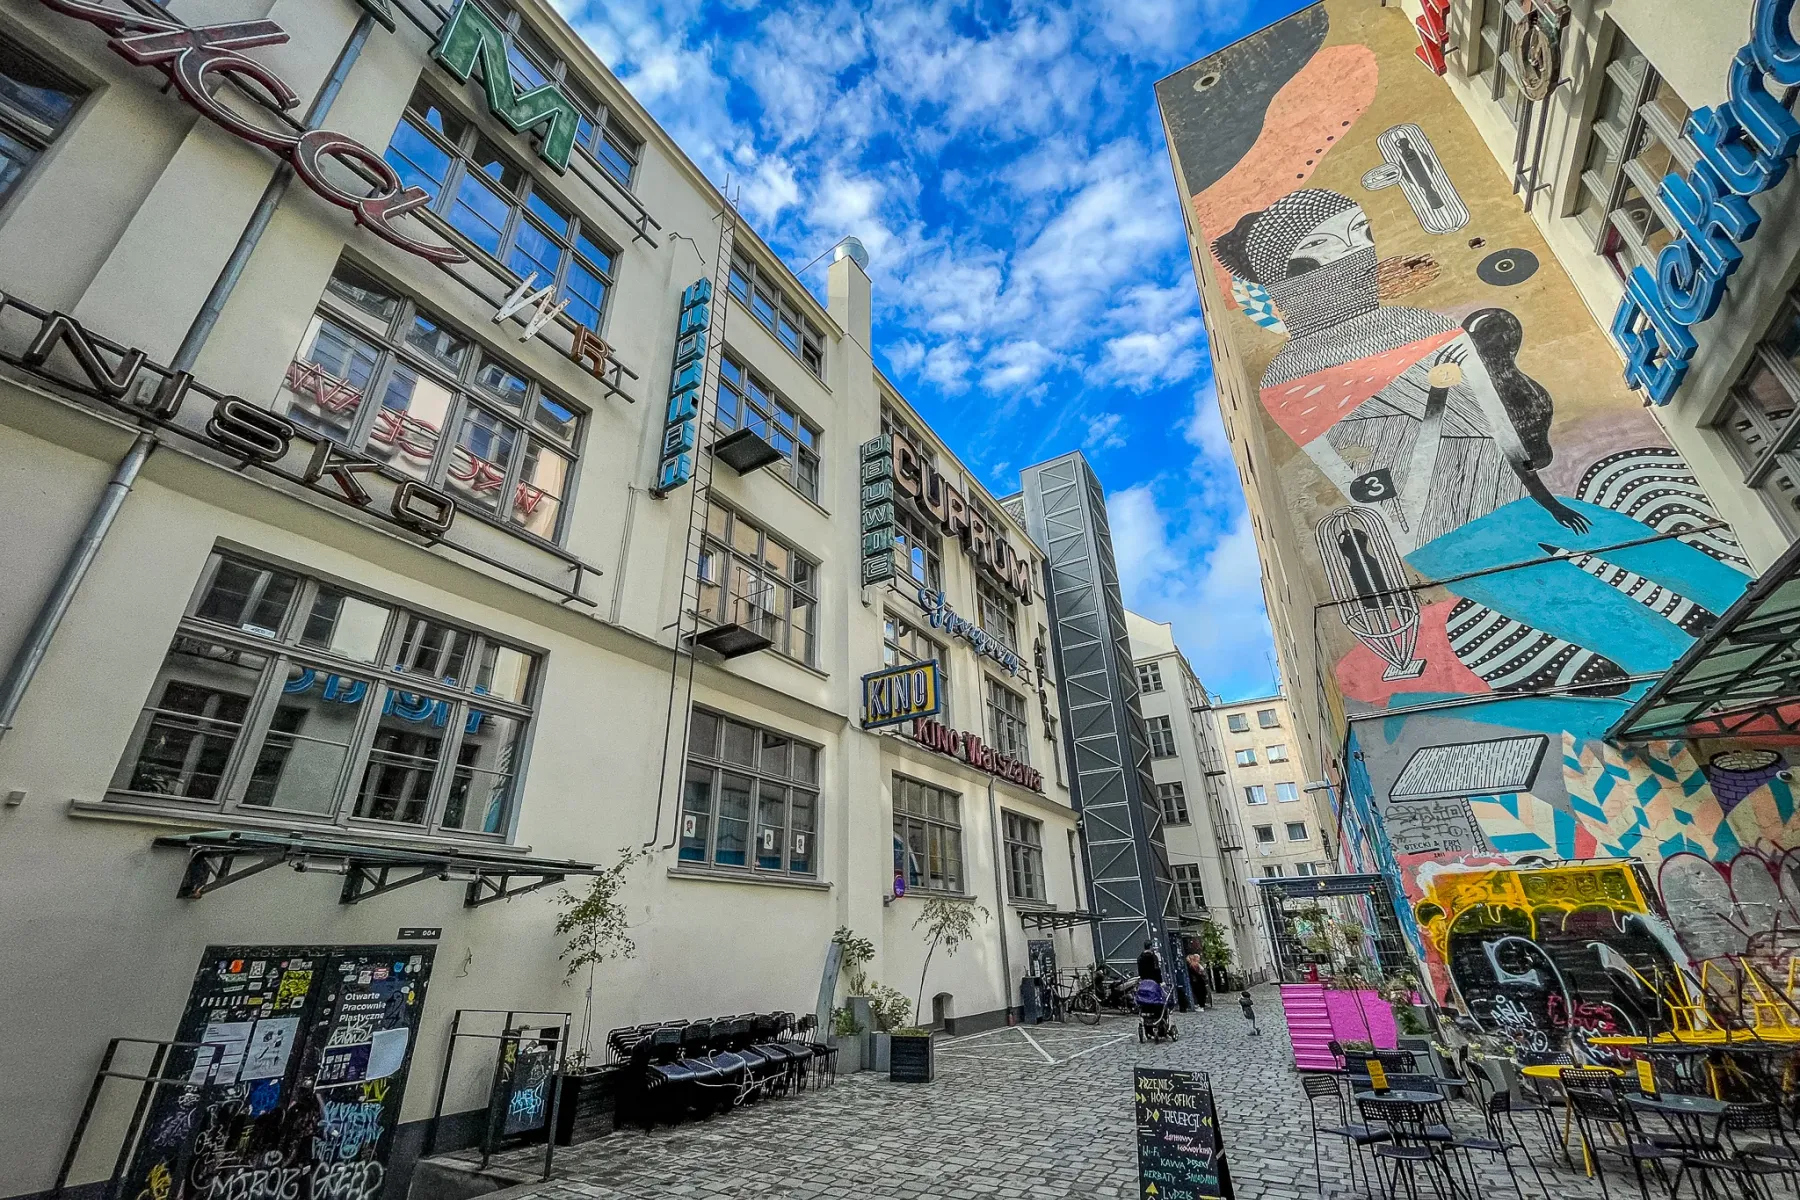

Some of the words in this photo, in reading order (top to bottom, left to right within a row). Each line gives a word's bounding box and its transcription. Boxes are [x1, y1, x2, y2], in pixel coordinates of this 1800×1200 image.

[22, 309, 458, 532] NISKO
[1364, 476, 1385, 497] 3
[862, 433, 896, 587] OBUWIE
[891, 432, 1033, 606] CUPRUM
[871, 669, 928, 718] KINO
[914, 716, 961, 756] KINO
[962, 730, 1043, 792] Warszawa
[1404, 841, 1431, 850] OTECKI
[341, 1002, 386, 1011] Pracownie
[345, 992, 380, 1000] Otwarte
[339, 1012, 385, 1022] Plastyczne
